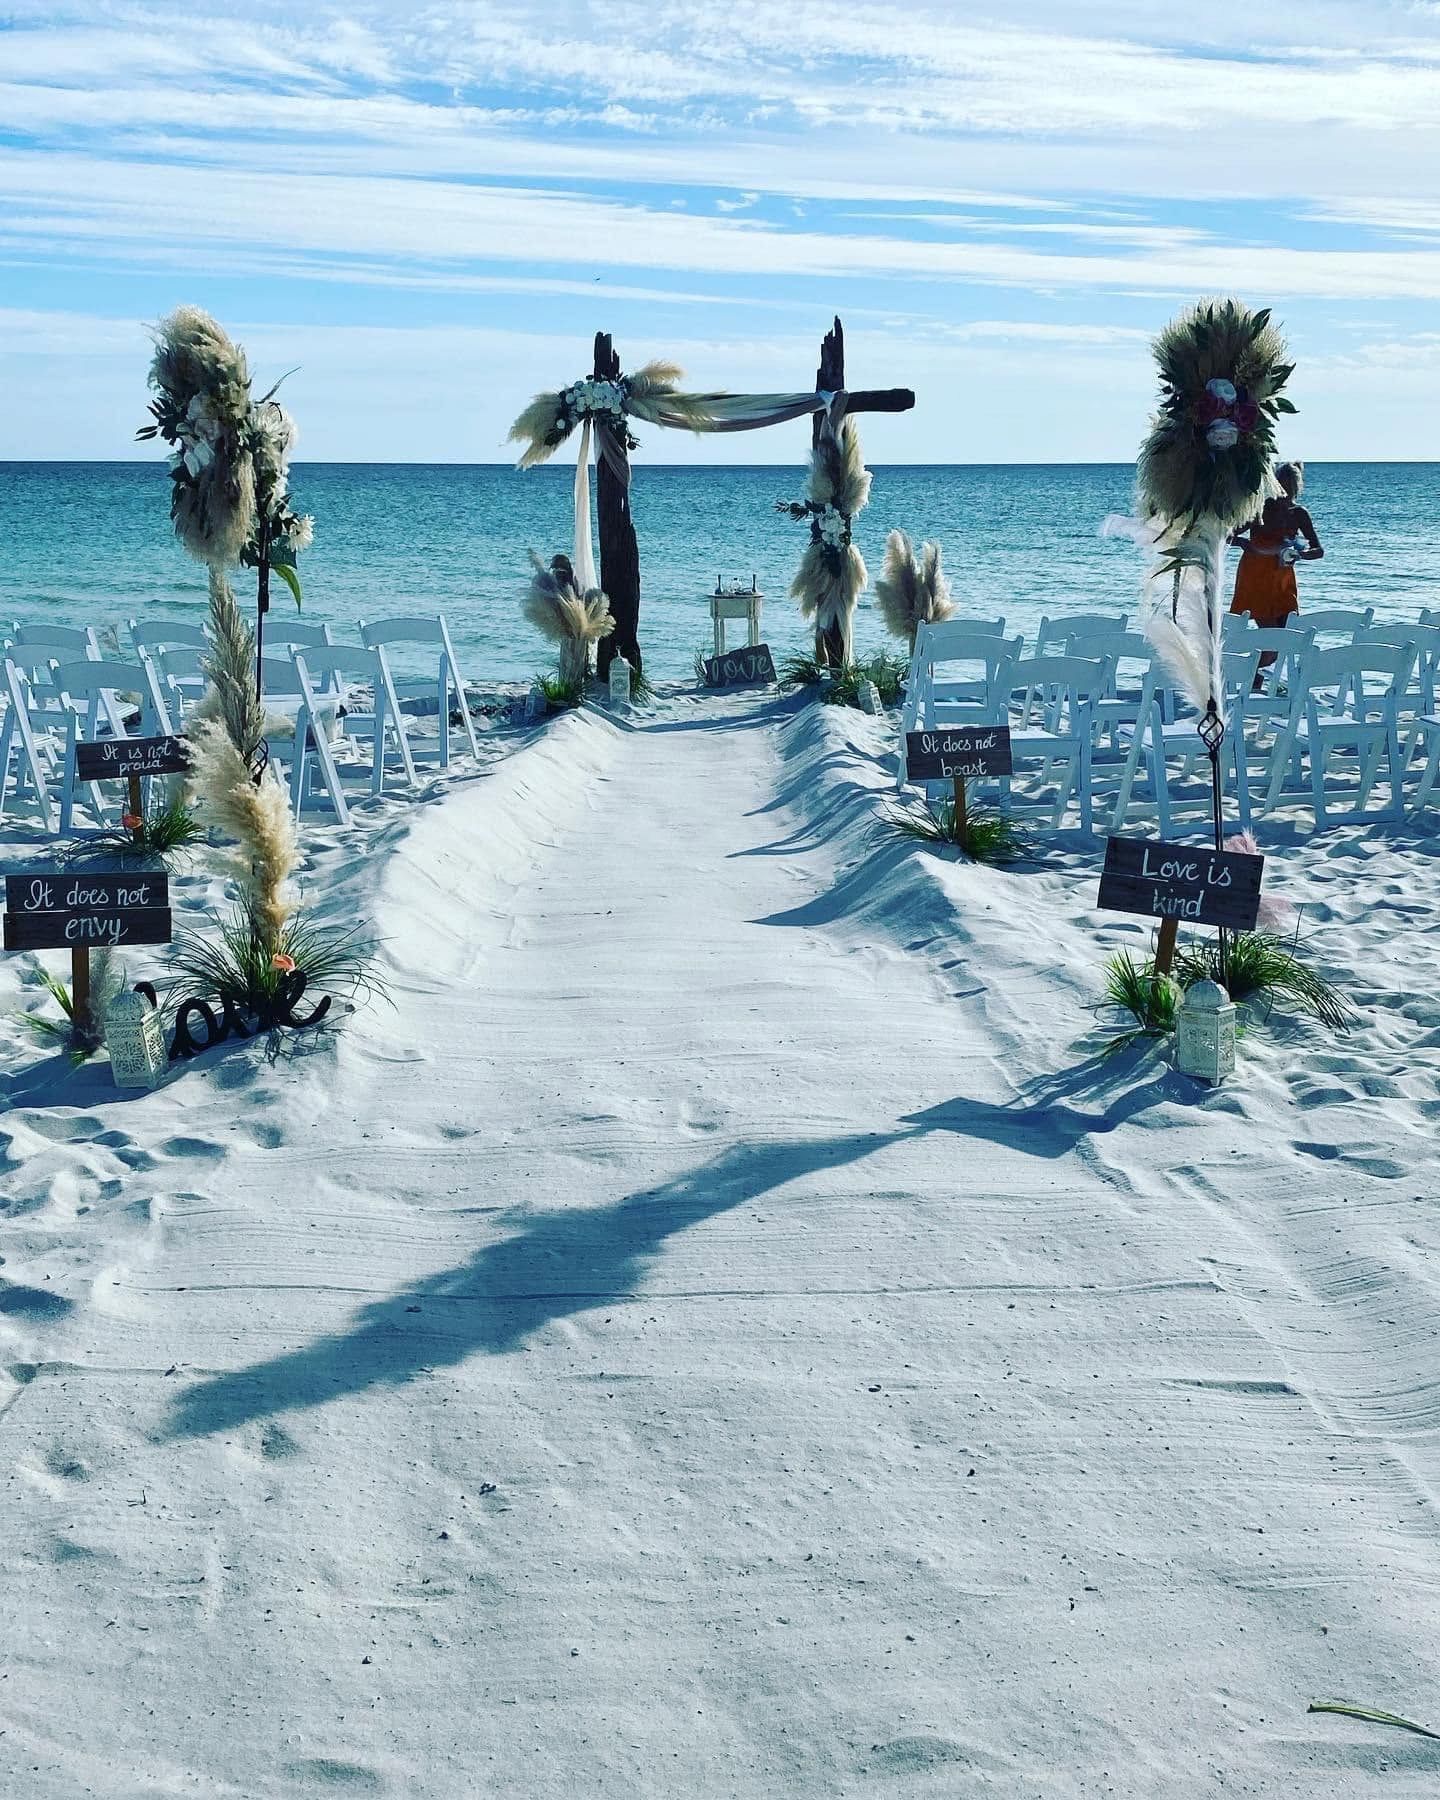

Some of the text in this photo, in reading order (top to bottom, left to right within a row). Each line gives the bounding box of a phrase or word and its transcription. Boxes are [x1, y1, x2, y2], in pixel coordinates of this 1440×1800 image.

[102, 740, 172, 761] It is not
[921, 732, 998, 754] It does not
[940, 758, 987, 777] boast
[1142, 848, 1232, 887] Love is
[24, 879, 150, 910] It does not
[1152, 888, 1205, 918] kind
[65, 917, 129, 945] envy
